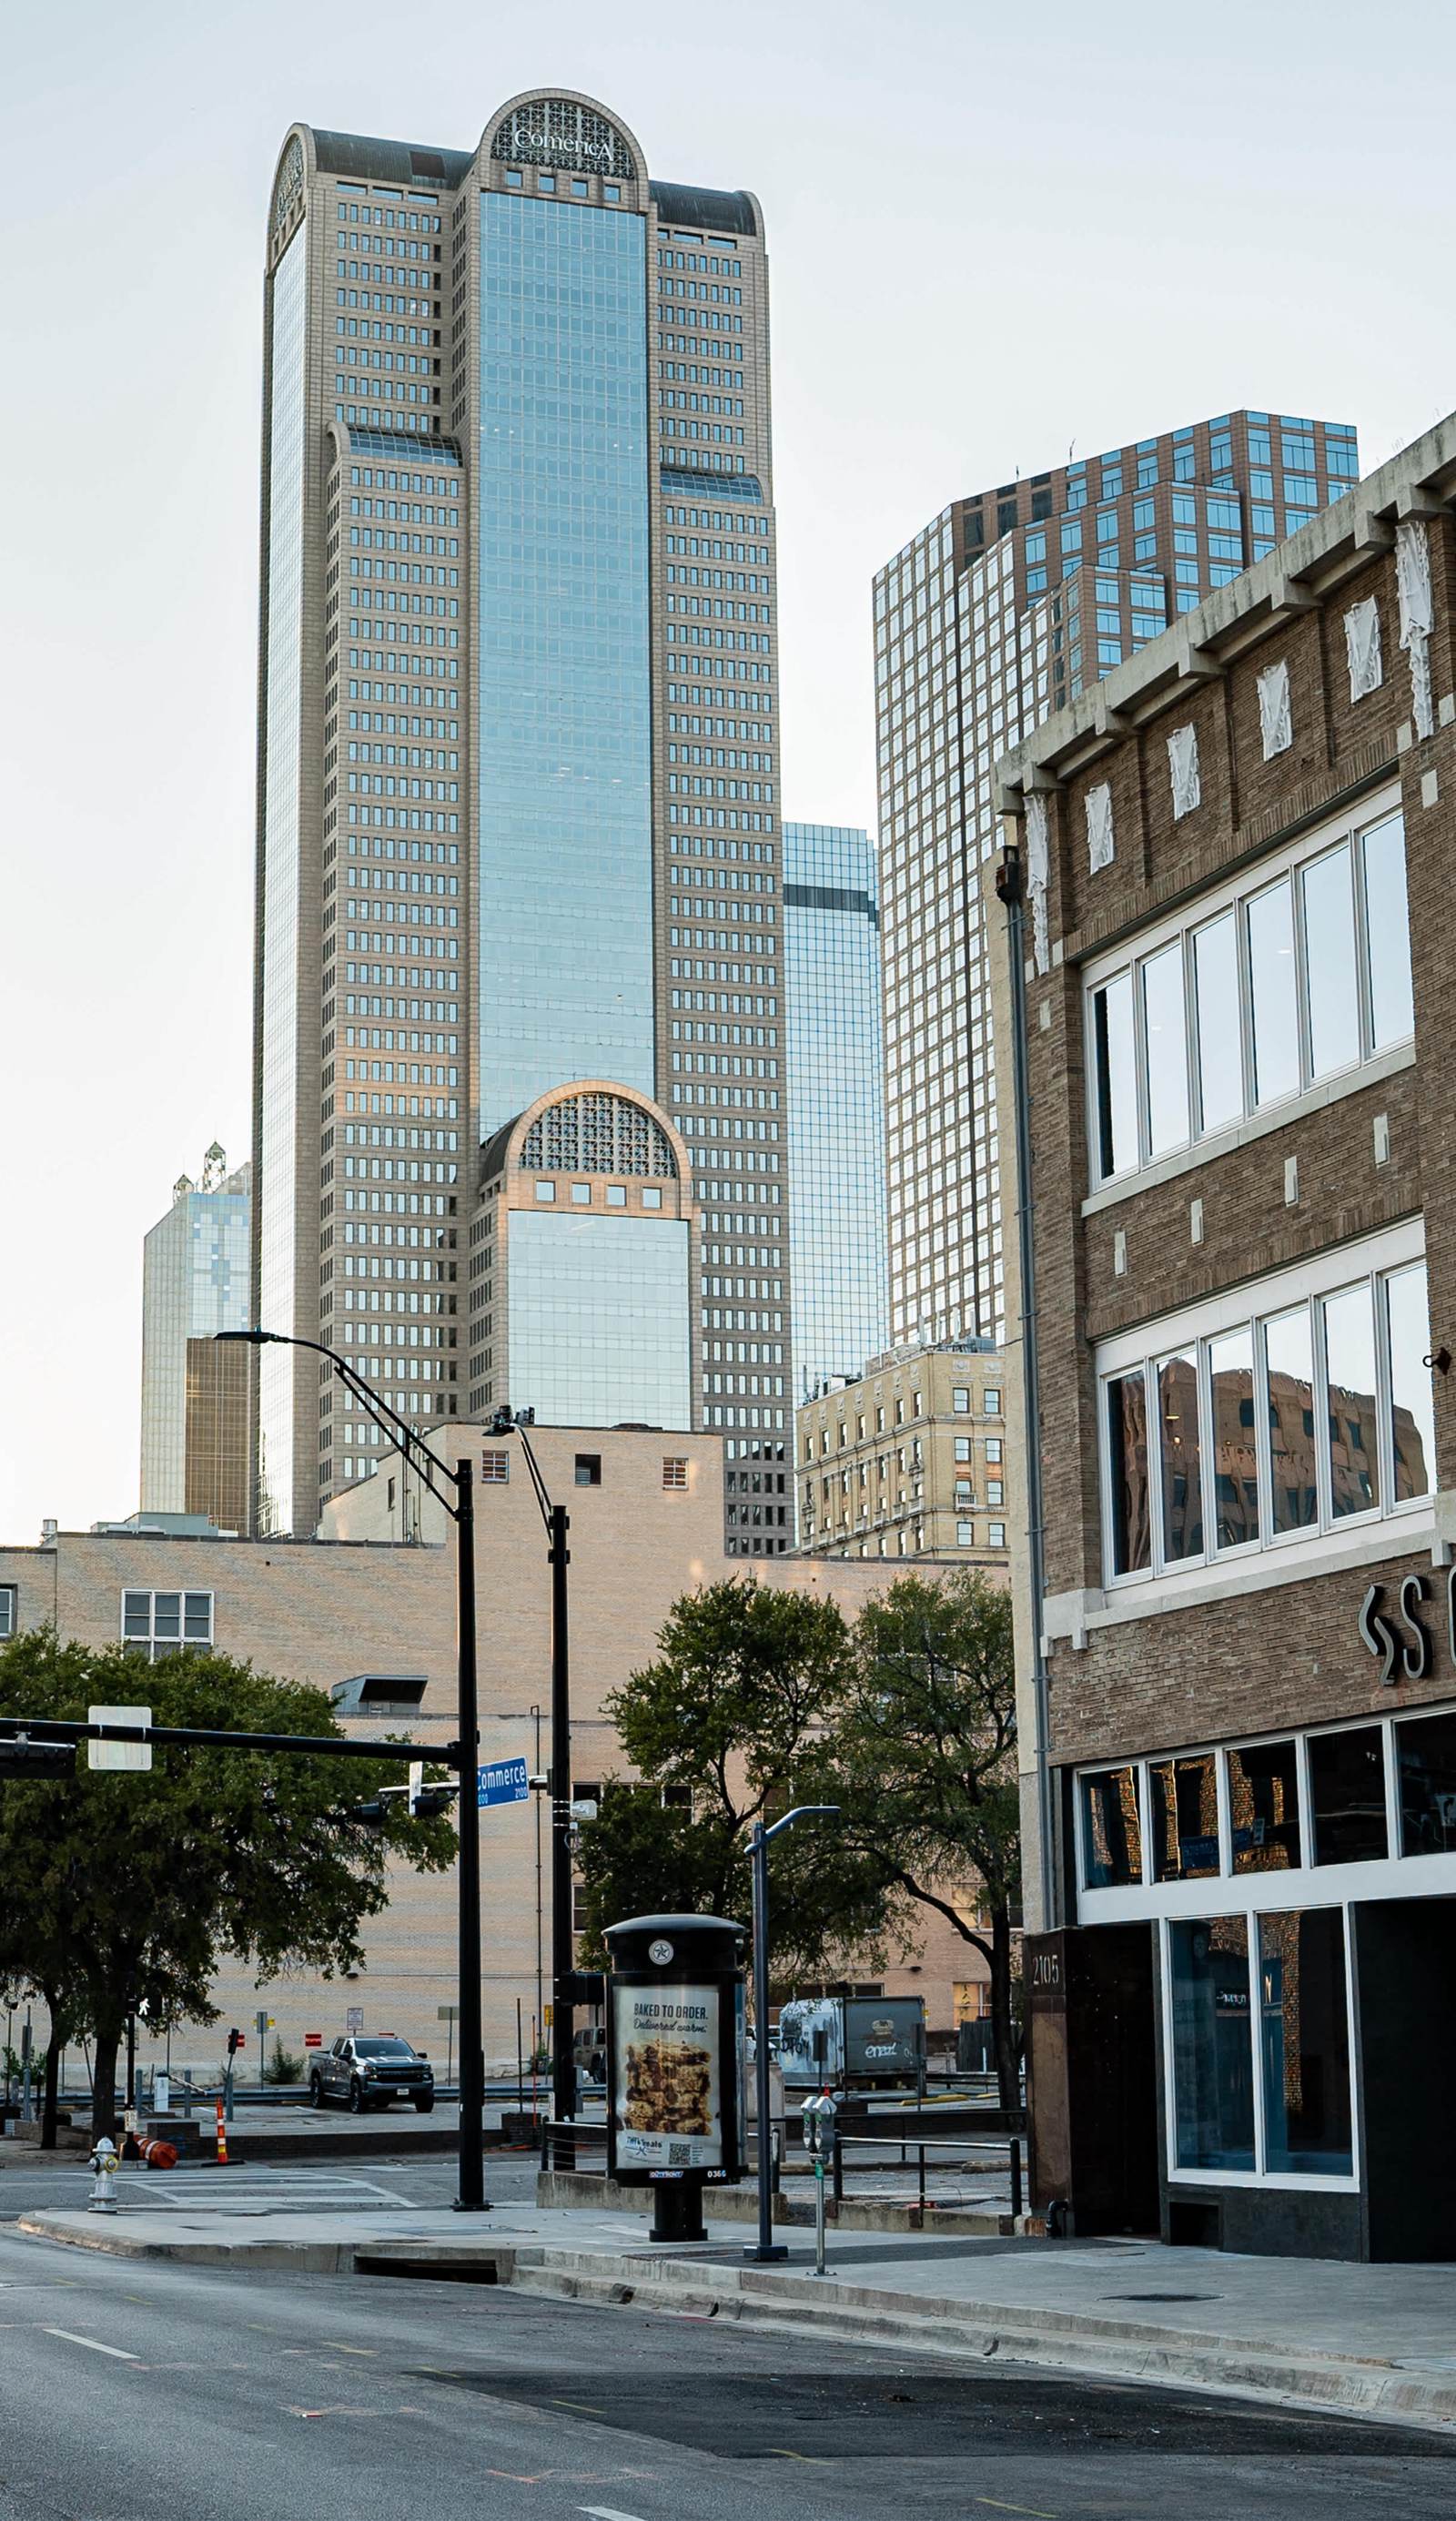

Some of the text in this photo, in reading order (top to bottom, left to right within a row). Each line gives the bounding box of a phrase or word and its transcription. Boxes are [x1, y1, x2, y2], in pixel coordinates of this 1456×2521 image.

[1033, 1955, 1059, 1984] 2105
[634, 2003, 708, 2020] BAKED TO ORDER.
